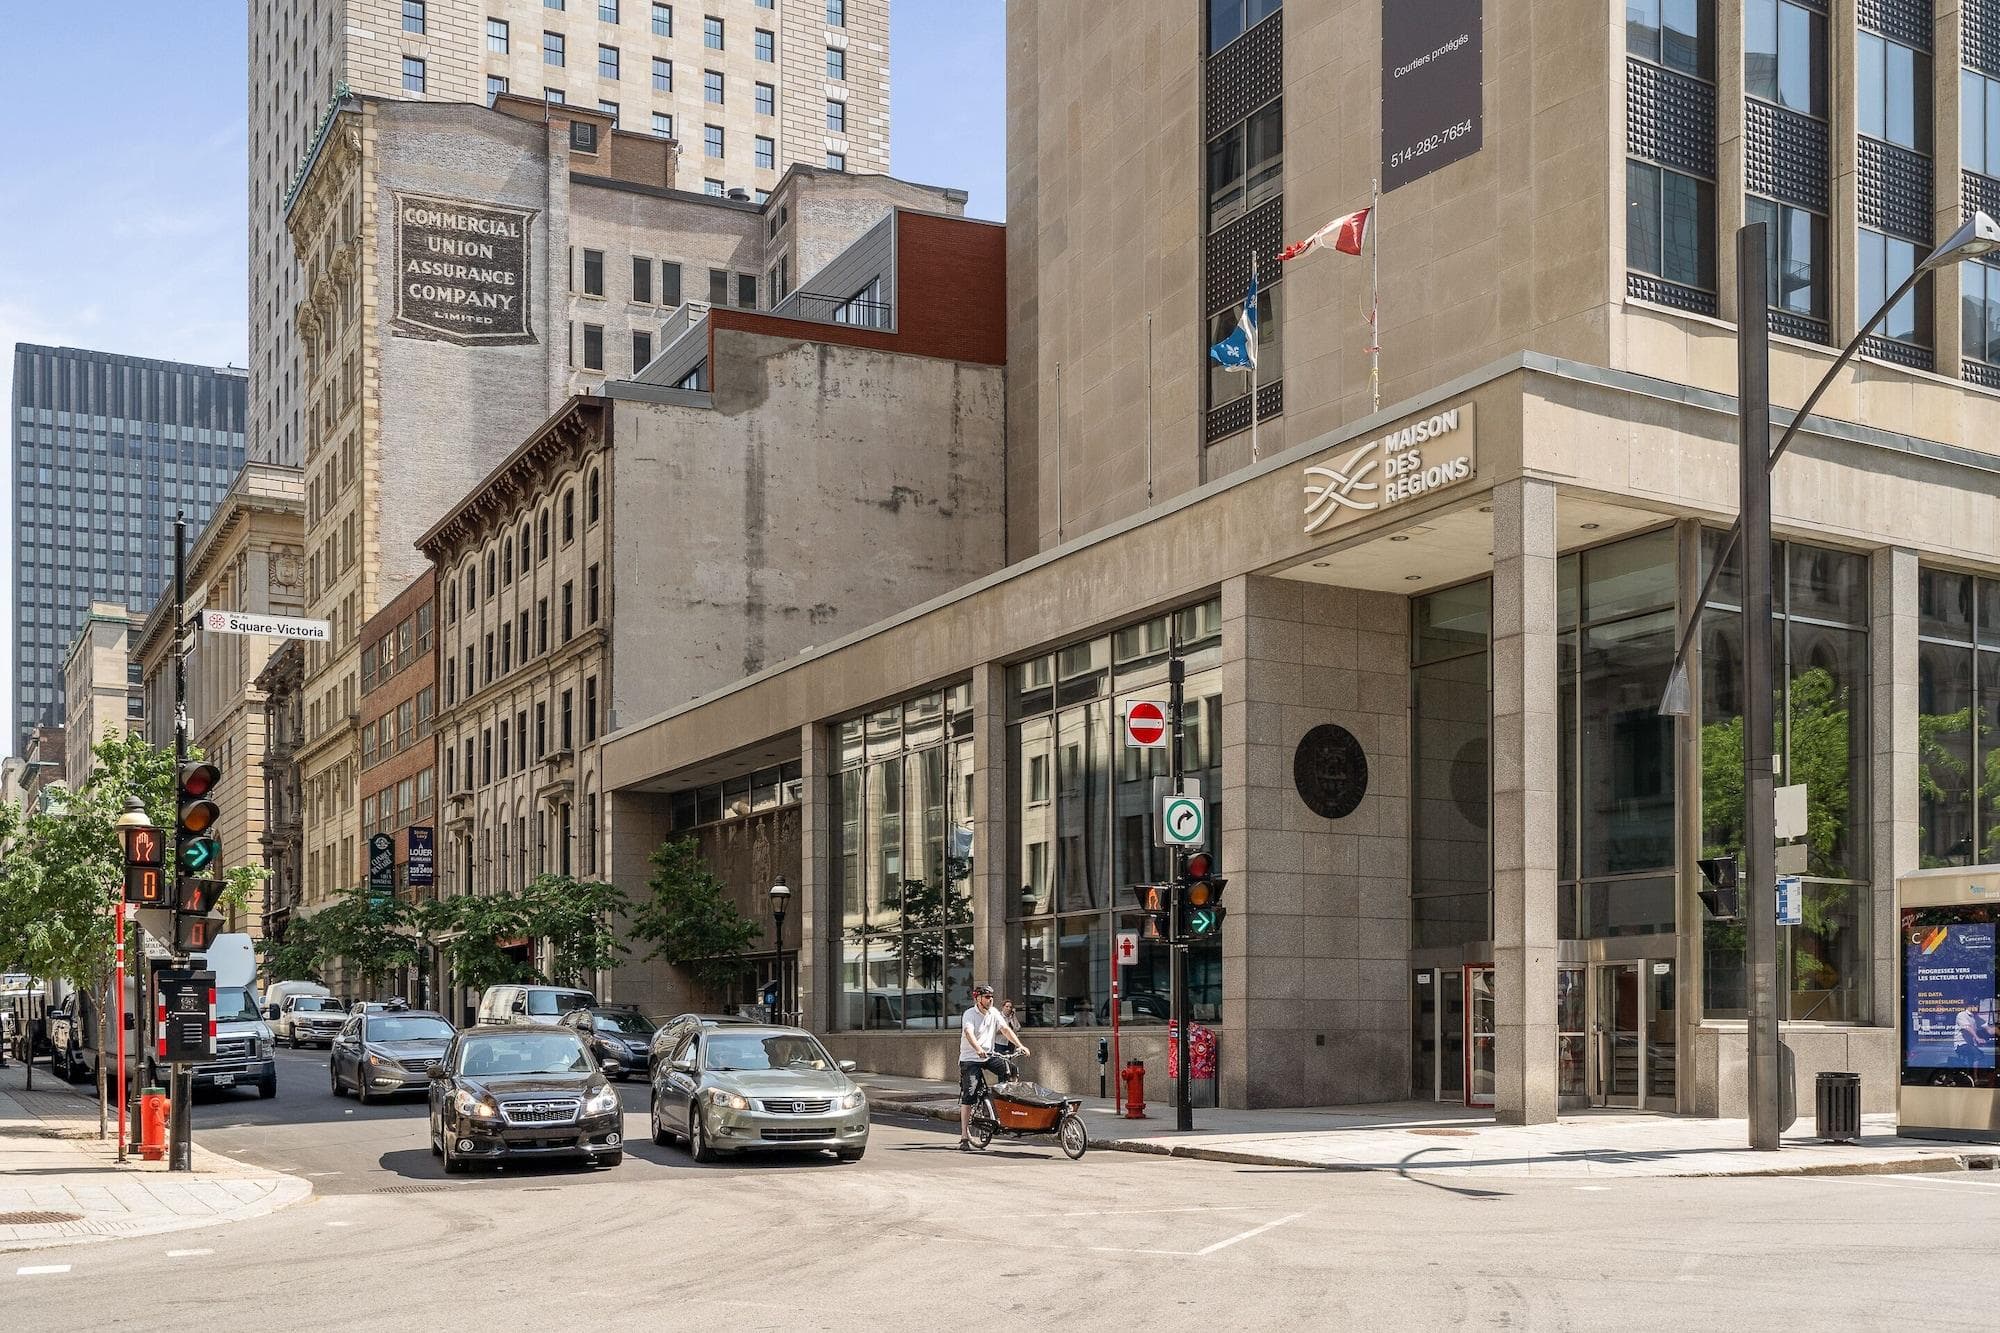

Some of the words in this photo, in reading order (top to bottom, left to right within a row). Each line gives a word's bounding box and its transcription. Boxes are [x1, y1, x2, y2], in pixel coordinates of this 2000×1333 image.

[1393, 53, 1431, 78] Courtiers
[1431, 33, 1469, 61] protégés
[1390, 119, 1472, 167] 514-282-7654
[404, 208, 520, 238] COMMERCIAL
[428, 237, 493, 260] UNION
[407, 259, 515, 285] ASSURANCE
[409, 284, 515, 310] COMPANY
[434, 311, 493, 324] LIMITED
[1385, 408, 1458, 455] MAISON
[1385, 449, 1421, 479] DES
[1385, 456, 1469, 504] RÉGIONS
[230, 619, 324, 637] Square-Victoria
